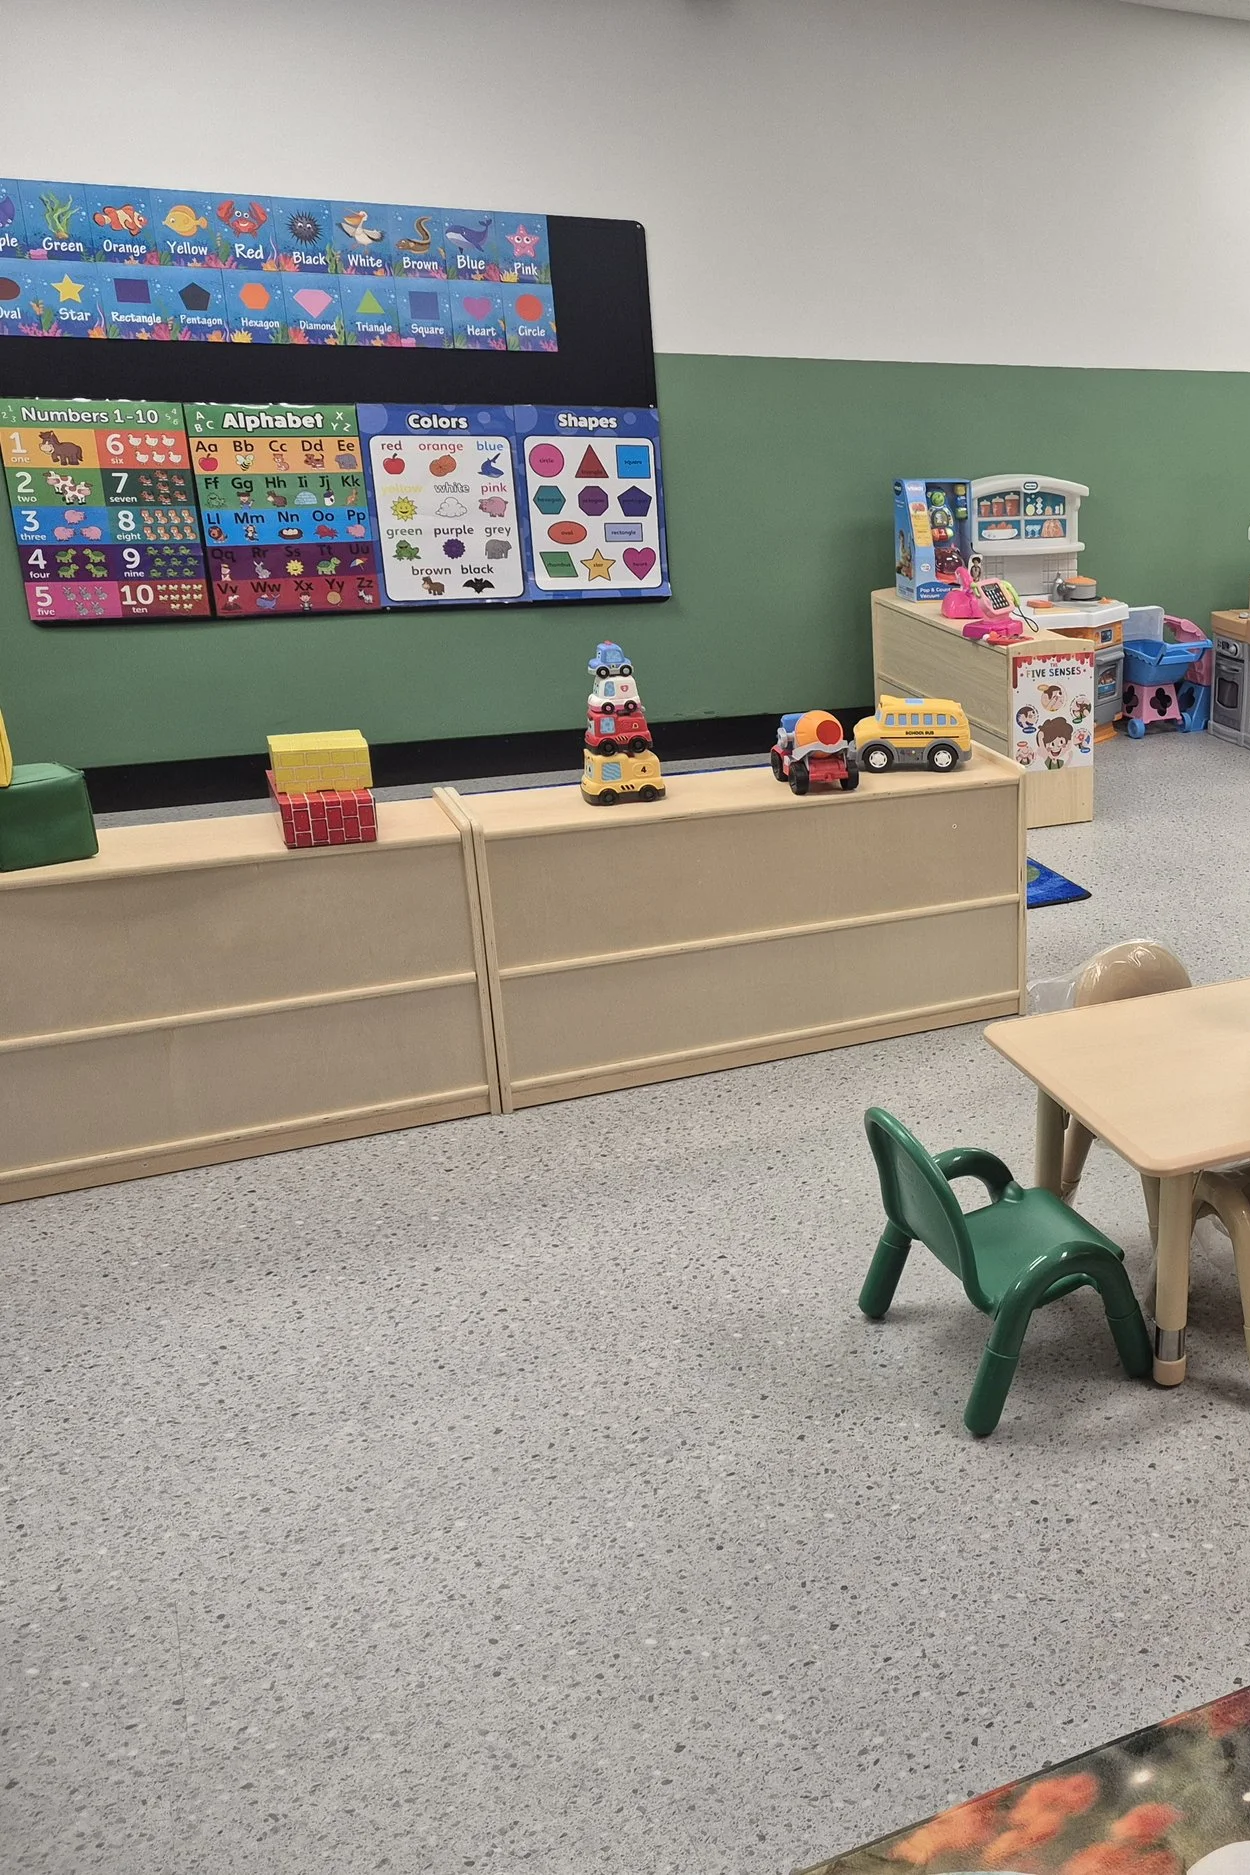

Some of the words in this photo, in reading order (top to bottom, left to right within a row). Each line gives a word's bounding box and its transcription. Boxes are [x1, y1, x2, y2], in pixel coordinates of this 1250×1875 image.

[42, 238, 84, 252] Green
[103, 239, 147, 256] Orange
[167, 241, 209, 256] Yellow
[234, 244, 265, 259] Red
[293, 251, 328, 266] Black
[347, 254, 383, 269] White
[403, 256, 438, 270] Brown
[456, 255, 485, 270] Blue
[513, 262, 539, 276] Pink
[59, 308, 91, 321] Star
[111, 311, 162, 325] Rectangle
[180, 314, 223, 327] Pentagon
[241, 317, 280, 330] Hexagon
[299, 320, 336, 331] Diamond
[355, 321, 393, 333] Triangle
[411, 323, 445, 337] Square
[466, 324, 497, 337] Heart
[518, 326, 546, 337] Circle
[21, 406, 109, 423] Numbers
[113, 409, 160, 424] 1-10
[196, 411, 205, 421] A
[335, 412, 344, 420] X
[408, 413, 469, 430] Colors
[173, 418, 179, 426] 6
[194, 423, 203, 433] B
[206, 420, 215, 429] C
[223, 412, 325, 432] Alphabet
[331, 423, 338, 431] Y
[343, 423, 352, 432] Z
[557, 413, 618, 431] Shapes
[10, 432, 27, 454] 1
[106, 433, 125, 455] 6
[195, 441, 218, 453] Aa
[233, 441, 255, 452] Bb
[269, 440, 288, 452] Cc
[301, 440, 324, 452] Dd
[338, 440, 355, 451] Ee
[381, 440, 403, 451] red
[418, 442, 464, 454] orange
[476, 441, 504, 451] blue
[11, 456, 30, 464] one
[111, 457, 124, 465] six
[15, 471, 34, 493] 2
[111, 472, 129, 493] 7
[204, 477, 220, 490] Ff
[231, 478, 254, 492] Gg
[265, 477, 287, 488] Hh
[299, 477, 308, 488] Ii
[319, 476, 332, 490] Jj
[341, 476, 360, 487] Kk
[434, 482, 470, 494] white
[381, 484, 424, 496] yellow
[481, 483, 507, 495] pink
[17, 495, 37, 503] two
[21, 510, 40, 532] 3
[118, 510, 136, 531] 8
[208, 513, 220, 525] Ll
[235, 512, 265, 524] Mm
[278, 511, 300, 522] Nn
[312, 510, 334, 521] Oo
[348, 510, 366, 524] Pp
[20, 533, 47, 541] three
[116, 532, 141, 542] eight
[386, 527, 423, 539] green
[434, 525, 474, 538] purple
[484, 526, 511, 537] grey
[27, 548, 48, 570] 4
[122, 548, 141, 569] 9
[212, 548, 235, 562] Qq
[252, 548, 268, 558] Rr
[285, 547, 301, 557] Ss
[319, 545, 333, 556] Tt
[350, 543, 370, 554] Uu
[29, 571, 50, 579] four
[124, 570, 145, 578] nine
[411, 566, 452, 576] brown
[461, 564, 494, 575] black
[217, 583, 238, 594] Vv
[250, 581, 281, 592] Ww
[294, 580, 314, 591] Xx
[326, 578, 344, 592] Yy
[357, 577, 373, 588] Zz
[35, 586, 53, 607] 5
[120, 584, 154, 606] 10
[37, 608, 55, 616] five
[132, 606, 148, 614] ten
[1026, 669, 1045, 678] FIVE
[1049, 667, 1081, 677] SENSES
